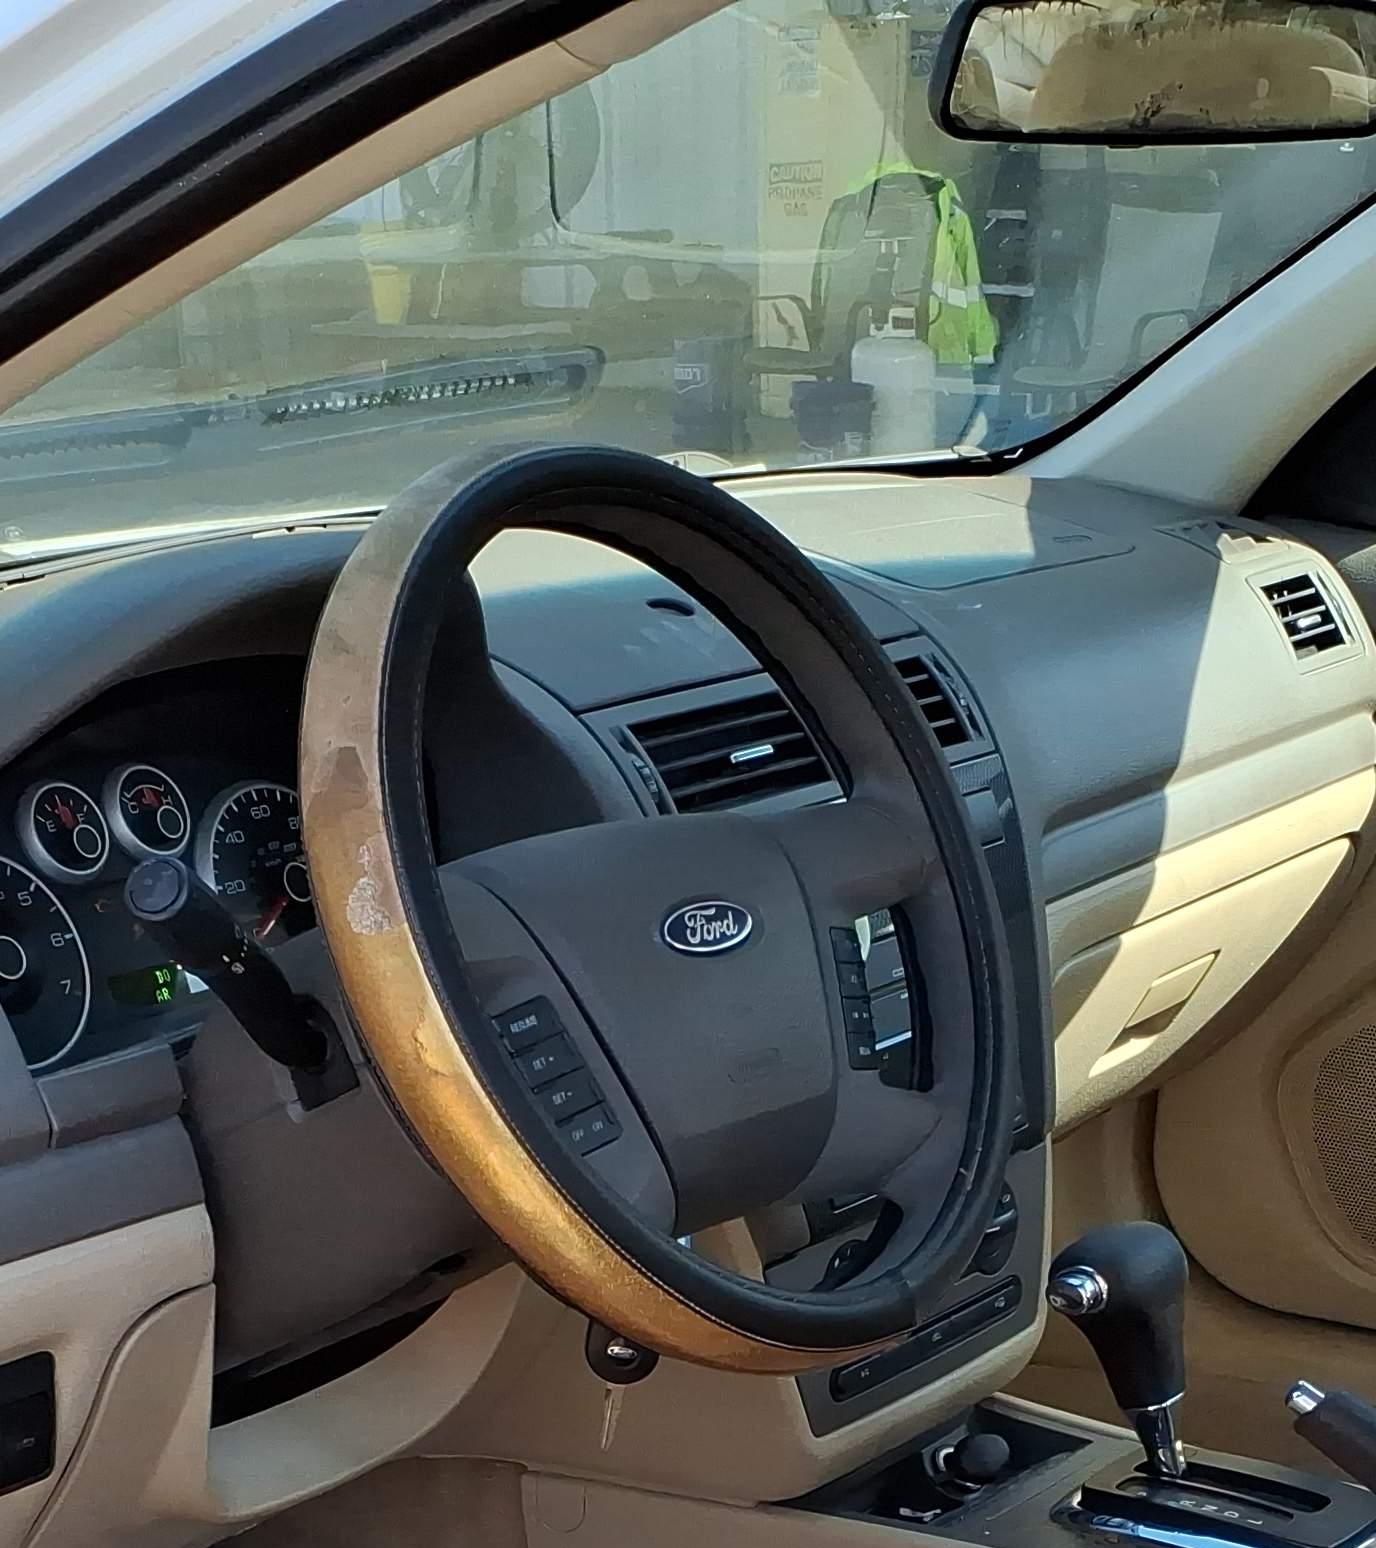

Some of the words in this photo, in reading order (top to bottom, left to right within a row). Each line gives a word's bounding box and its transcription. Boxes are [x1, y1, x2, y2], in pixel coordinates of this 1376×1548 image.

[250, 805, 270, 820] 60
[45, 819, 57, 833] E
[225, 830, 245, 844] 40
[224, 879, 246, 894] 20
[17, 891, 33, 906] 5
[684, 907, 738, 944] Ford
[50, 932, 65, 947] 6
[60, 979, 71, 995] 7
